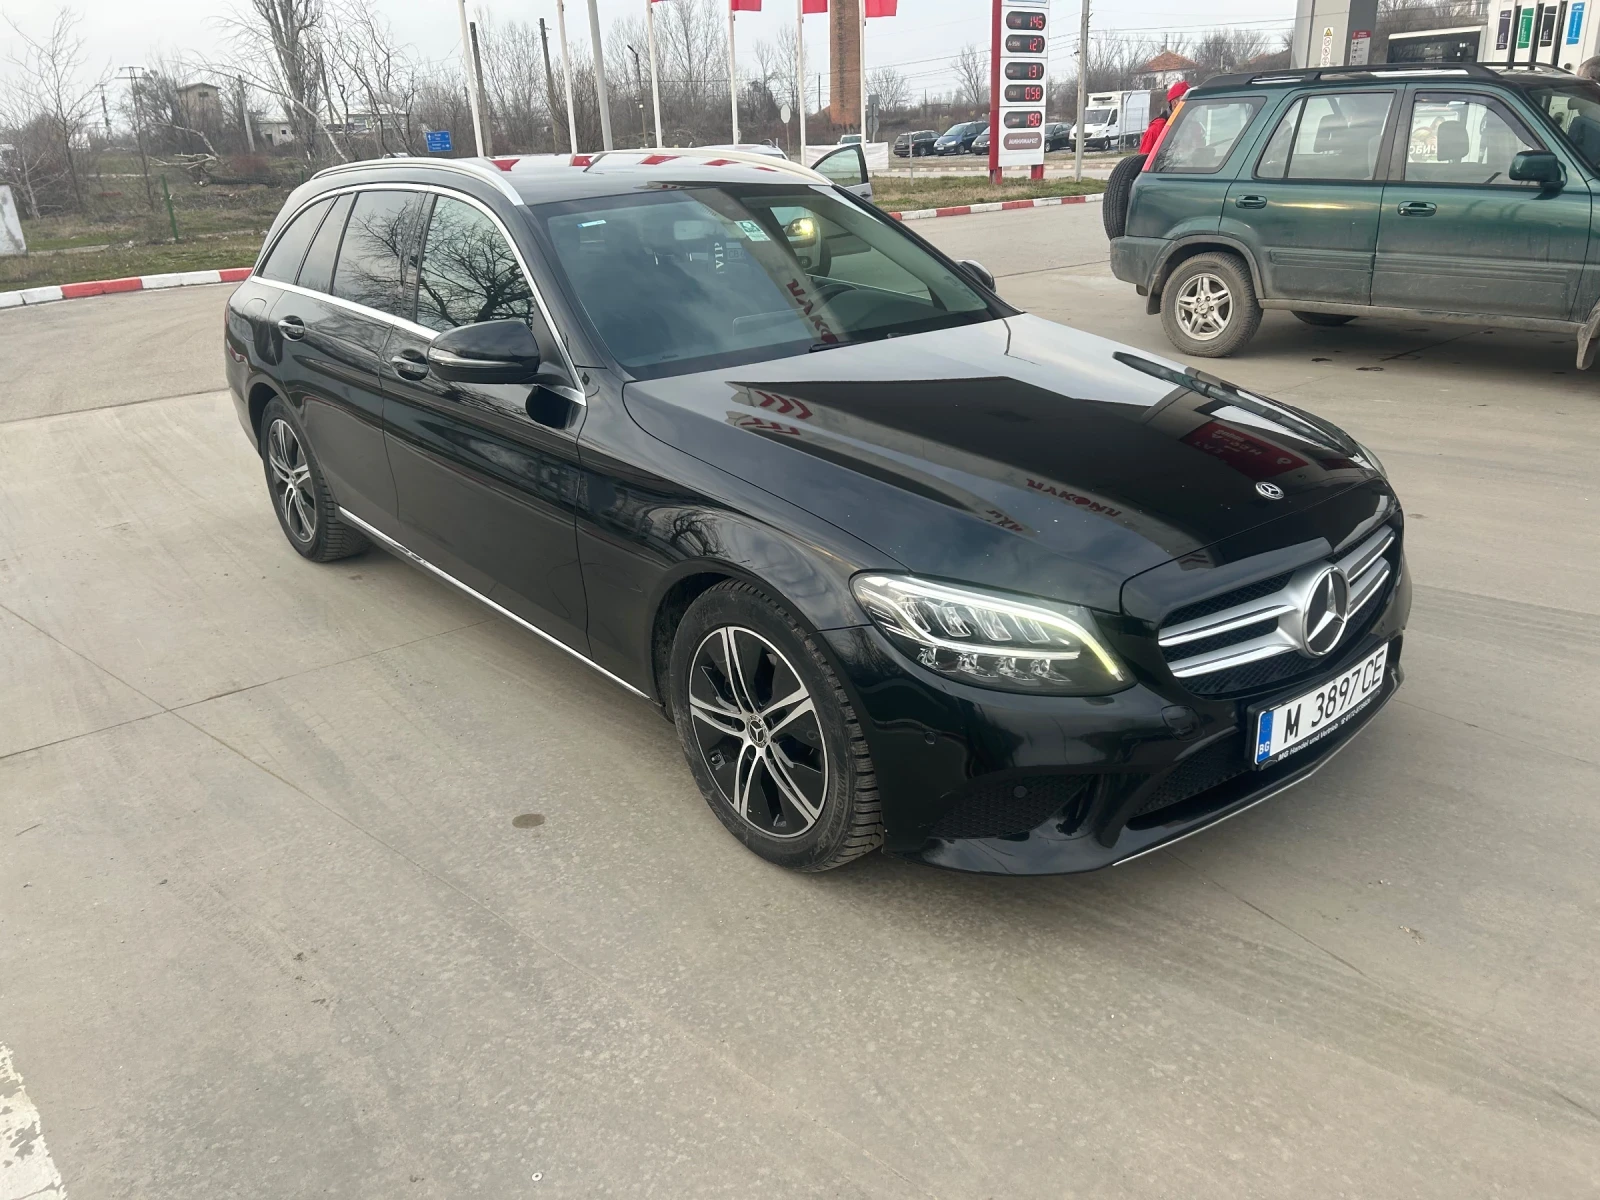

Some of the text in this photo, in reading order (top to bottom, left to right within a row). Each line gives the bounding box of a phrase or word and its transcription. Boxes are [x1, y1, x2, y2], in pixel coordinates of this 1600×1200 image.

[714, 242, 724, 269] VIP
[1284, 703, 1301, 743] M
[1311, 668, 1361, 727] 3897
[1259, 742, 1270, 755] BG
[1289, 739, 1309, 755] Handel
[1309, 734, 1320, 744] und
